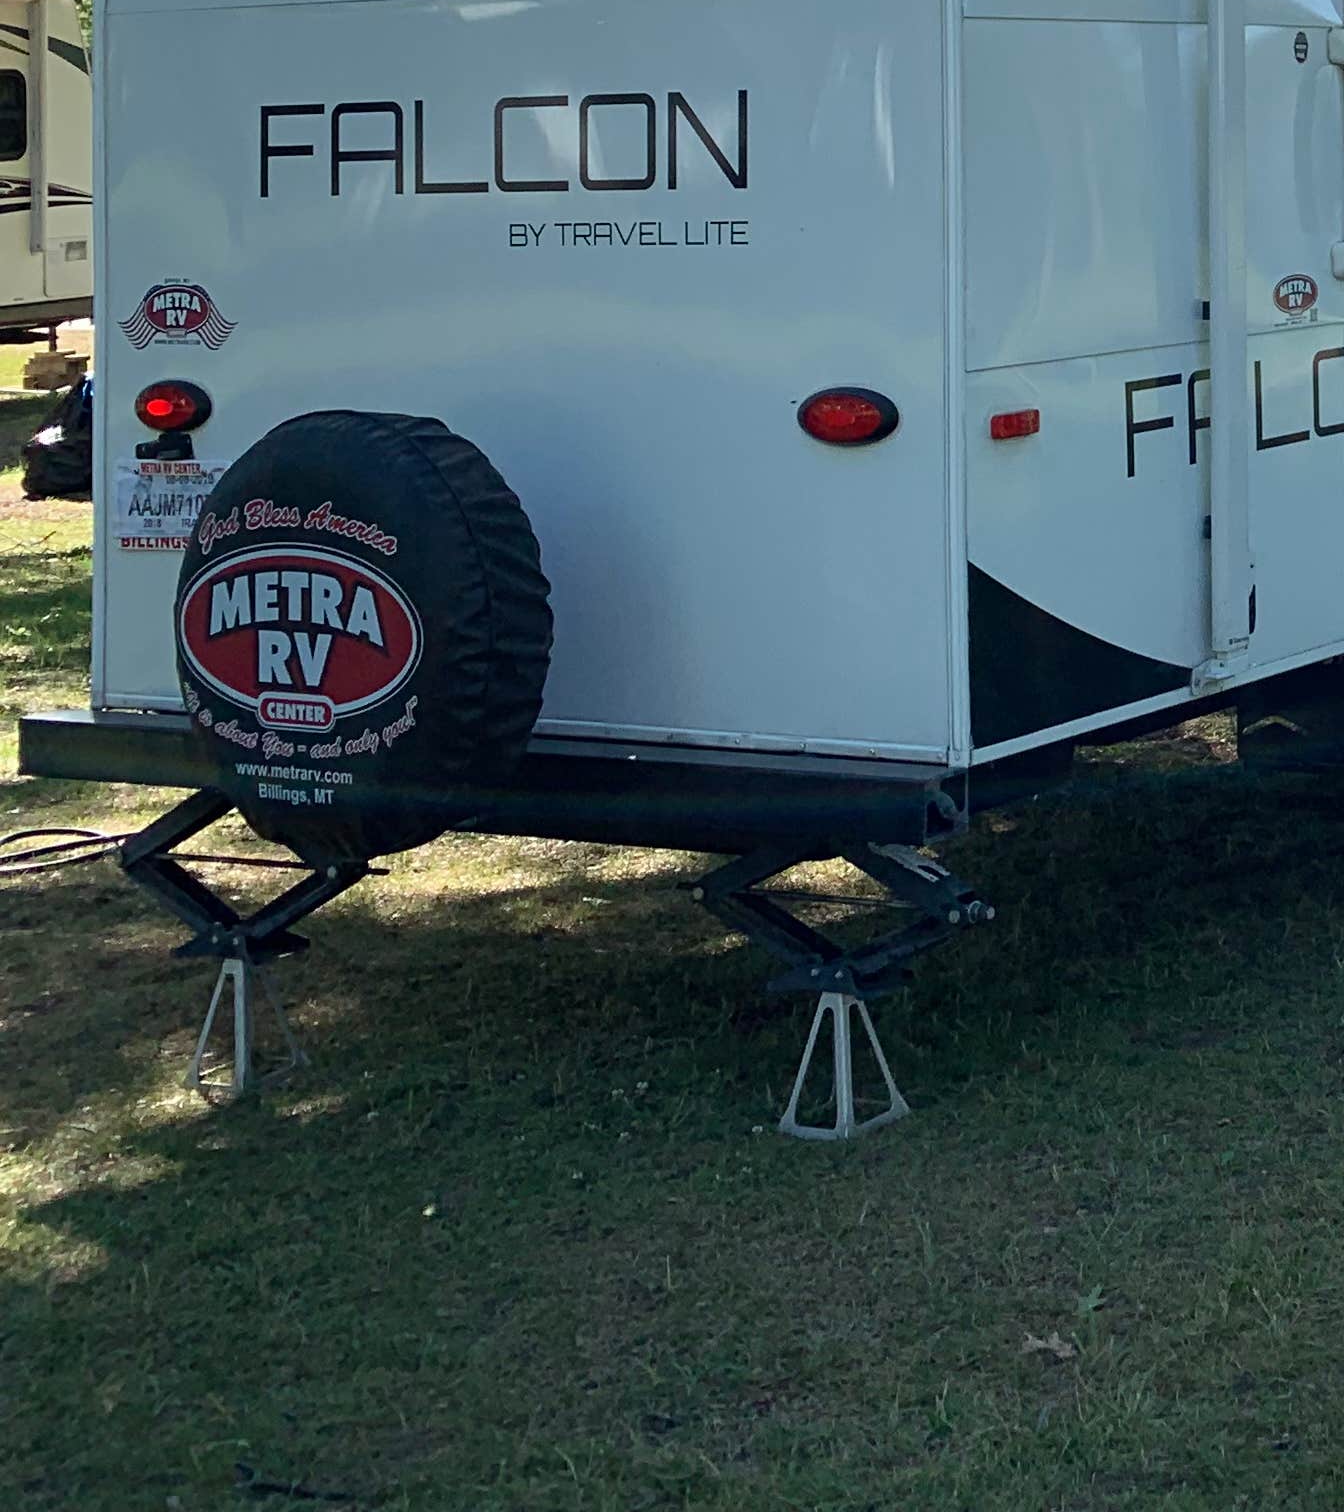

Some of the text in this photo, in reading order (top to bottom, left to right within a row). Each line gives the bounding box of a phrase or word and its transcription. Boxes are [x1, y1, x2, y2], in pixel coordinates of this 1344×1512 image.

[260, 89, 748, 198] FALCON
[509, 220, 749, 248] BY TRAVEL LITE
[1279, 279, 1313, 298] METRA
[1288, 293, 1303, 308] RV
[152, 291, 202, 313] METRA
[165, 309, 188, 327] RV
[199, 498, 397, 555] God Bless America
[209, 570, 384, 648] METRA
[257, 629, 333, 687] RV
[266, 701, 326, 723] CENTER
[214, 719, 259, 749] about
[261, 731, 295, 760] You
[309, 736, 342, 759] and
[344, 727, 380, 755] only
[234, 761, 353, 786] www.metrarv.com
[258, 783, 335, 805] Billings, MT
